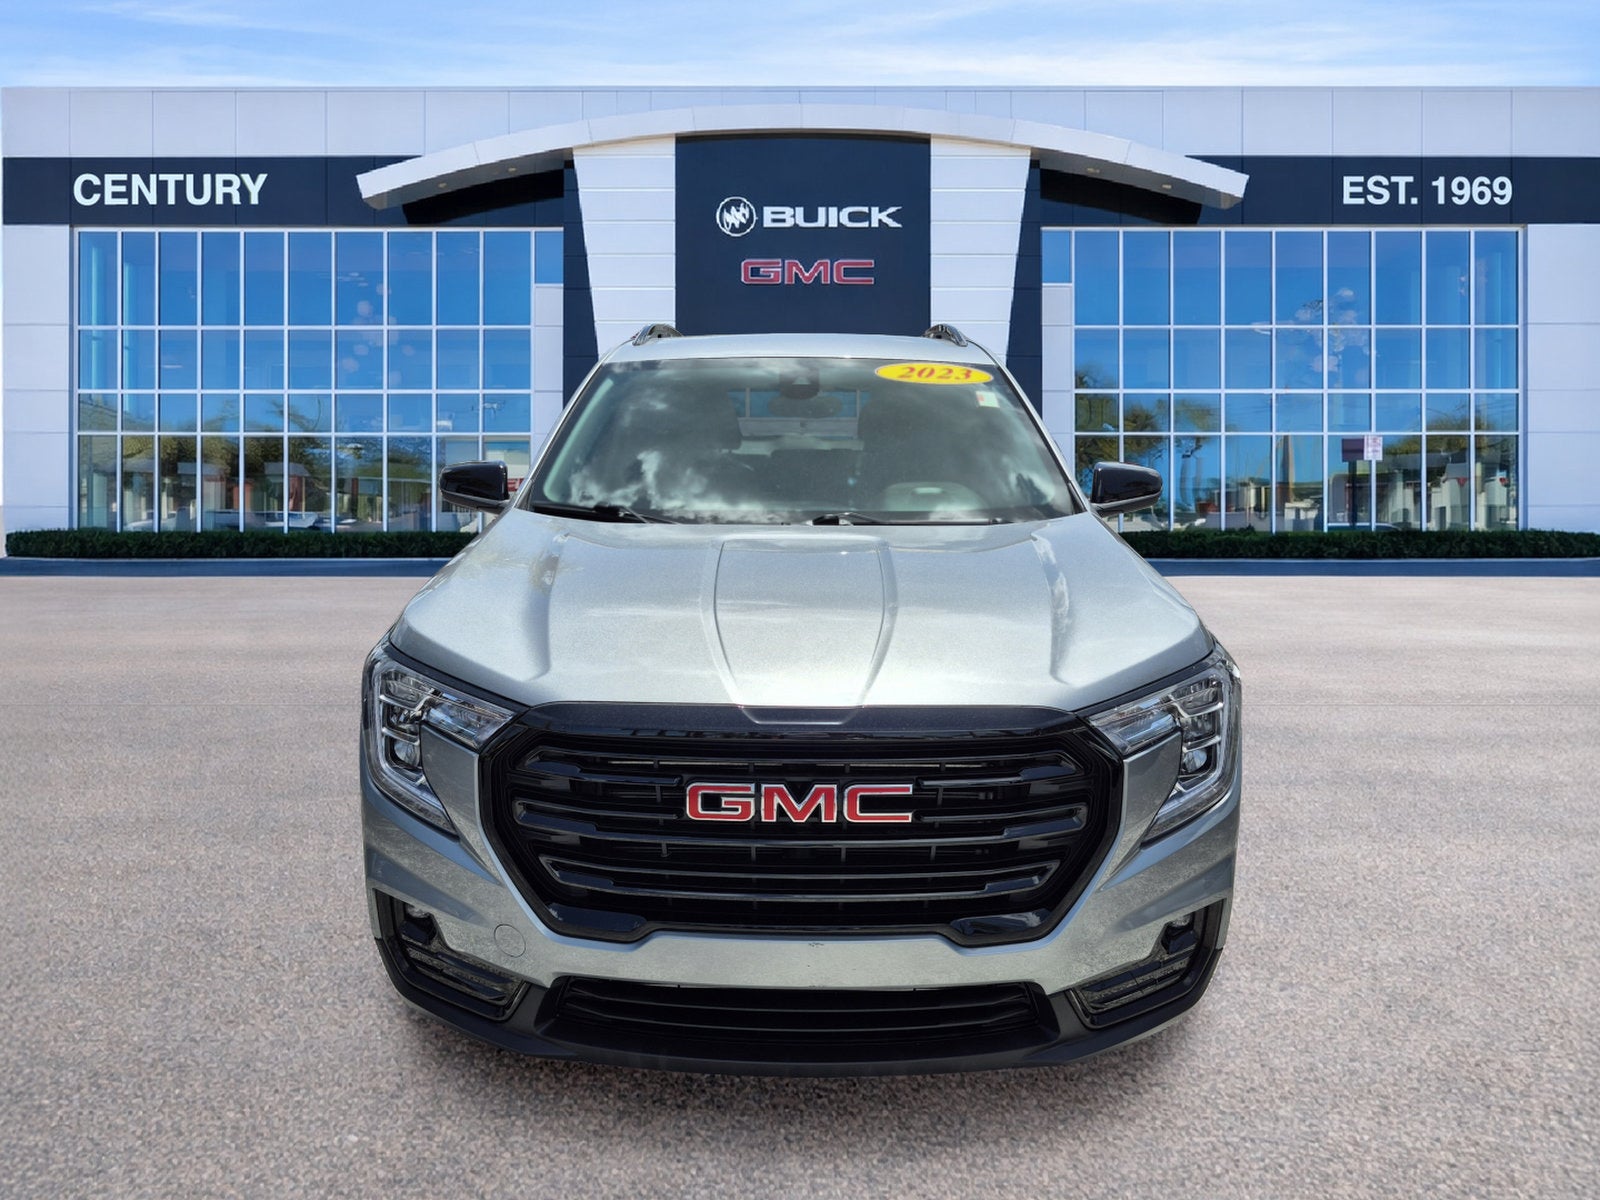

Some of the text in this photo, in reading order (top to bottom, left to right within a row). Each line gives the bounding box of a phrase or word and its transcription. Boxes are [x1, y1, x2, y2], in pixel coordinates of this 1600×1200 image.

[73, 173, 268, 206] CENTURY
[1342, 175, 1513, 205] EST. 1969
[762, 206, 903, 228] BUICK
[740, 258, 875, 285] GMC
[897, 366, 972, 380] 2023
[685, 782, 914, 824] GMC
